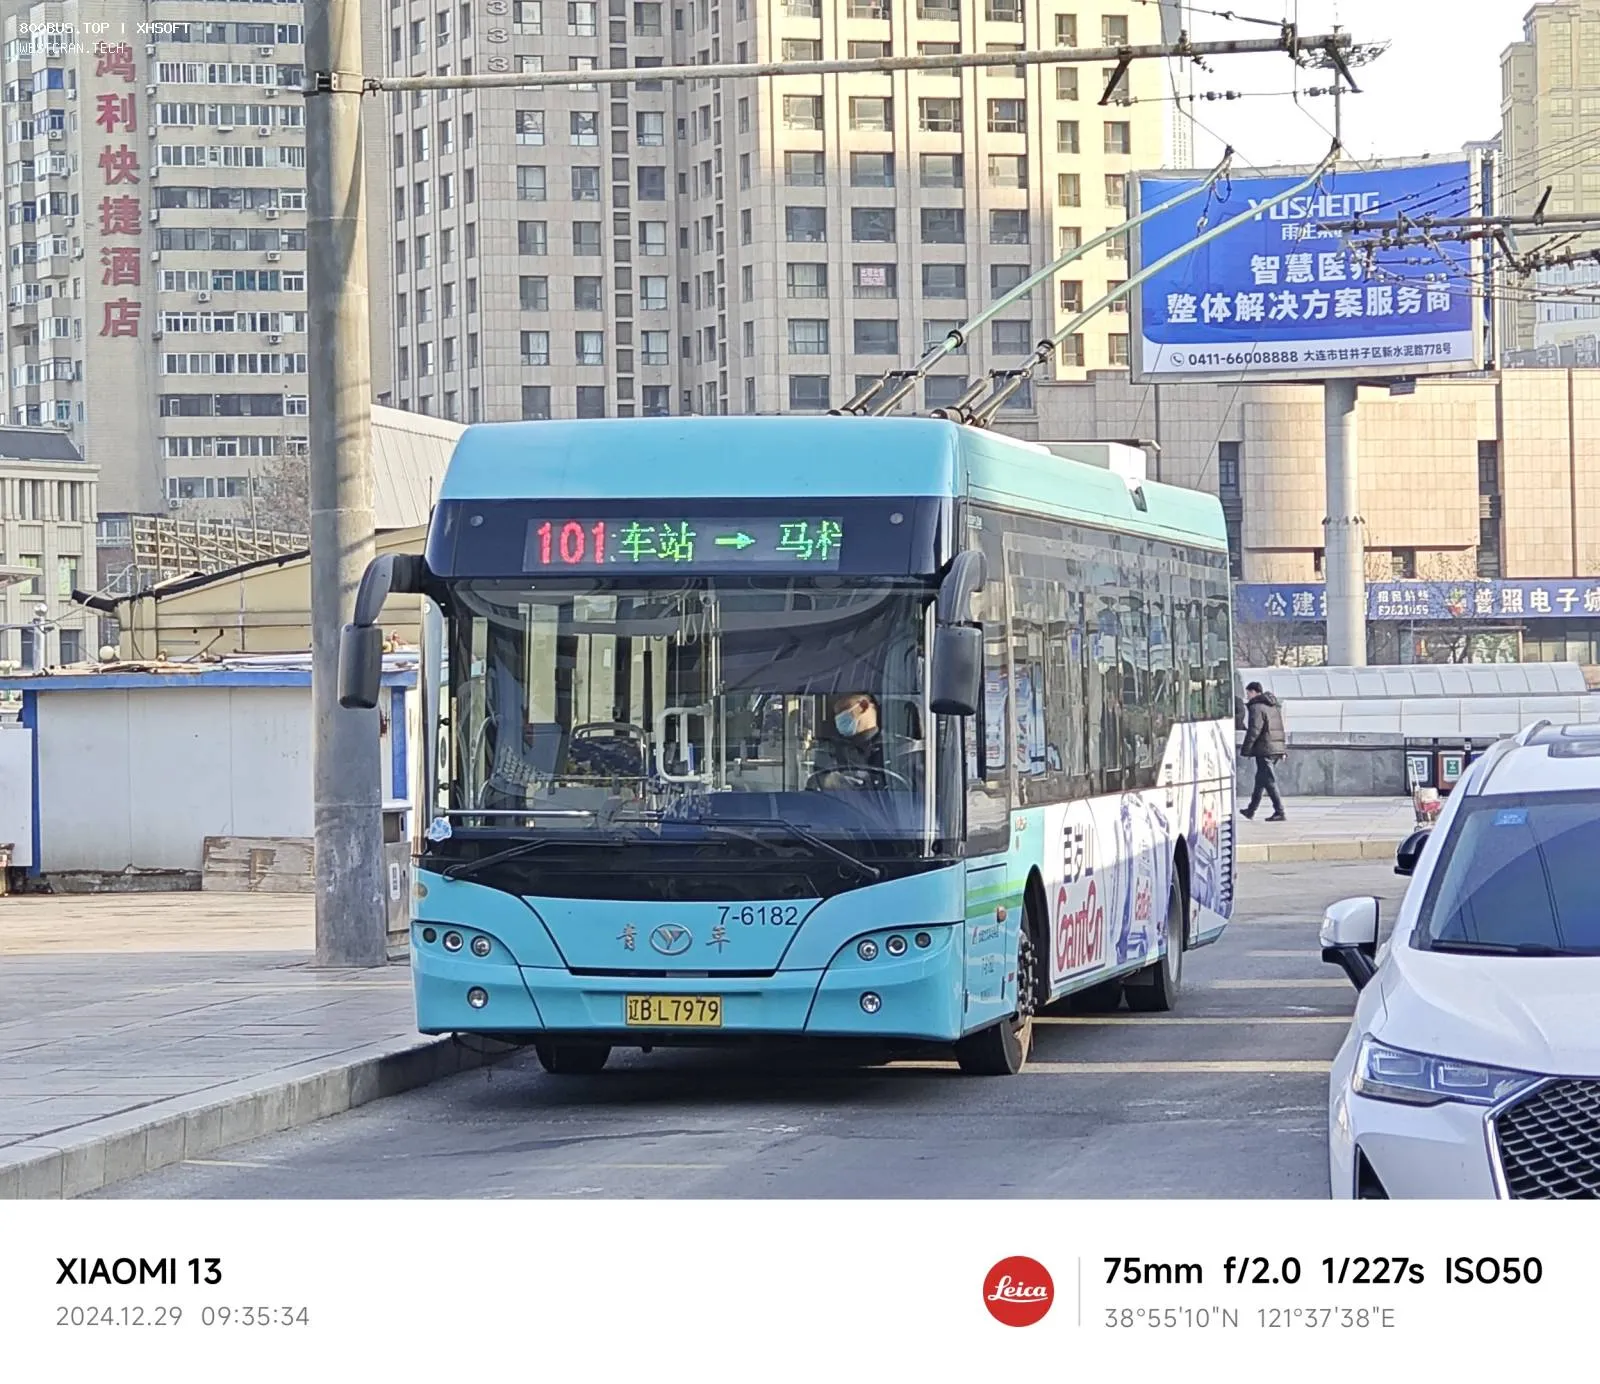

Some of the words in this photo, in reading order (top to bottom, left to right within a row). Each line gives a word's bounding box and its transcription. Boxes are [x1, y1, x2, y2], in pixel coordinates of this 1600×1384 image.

[96, 41, 142, 338] 鸿利快捷酒店
[1167, 283, 1450, 324] 整体解决方案服务商
[1188, 351, 1299, 366] 0411-66008888
[1303, 342, 1452, 362] 大连市甘井子区新水泥路778号
[537, 521, 605, 564] 101
[618, 521, 697, 562] 车站
[717, 906, 798, 926] 7-6182
